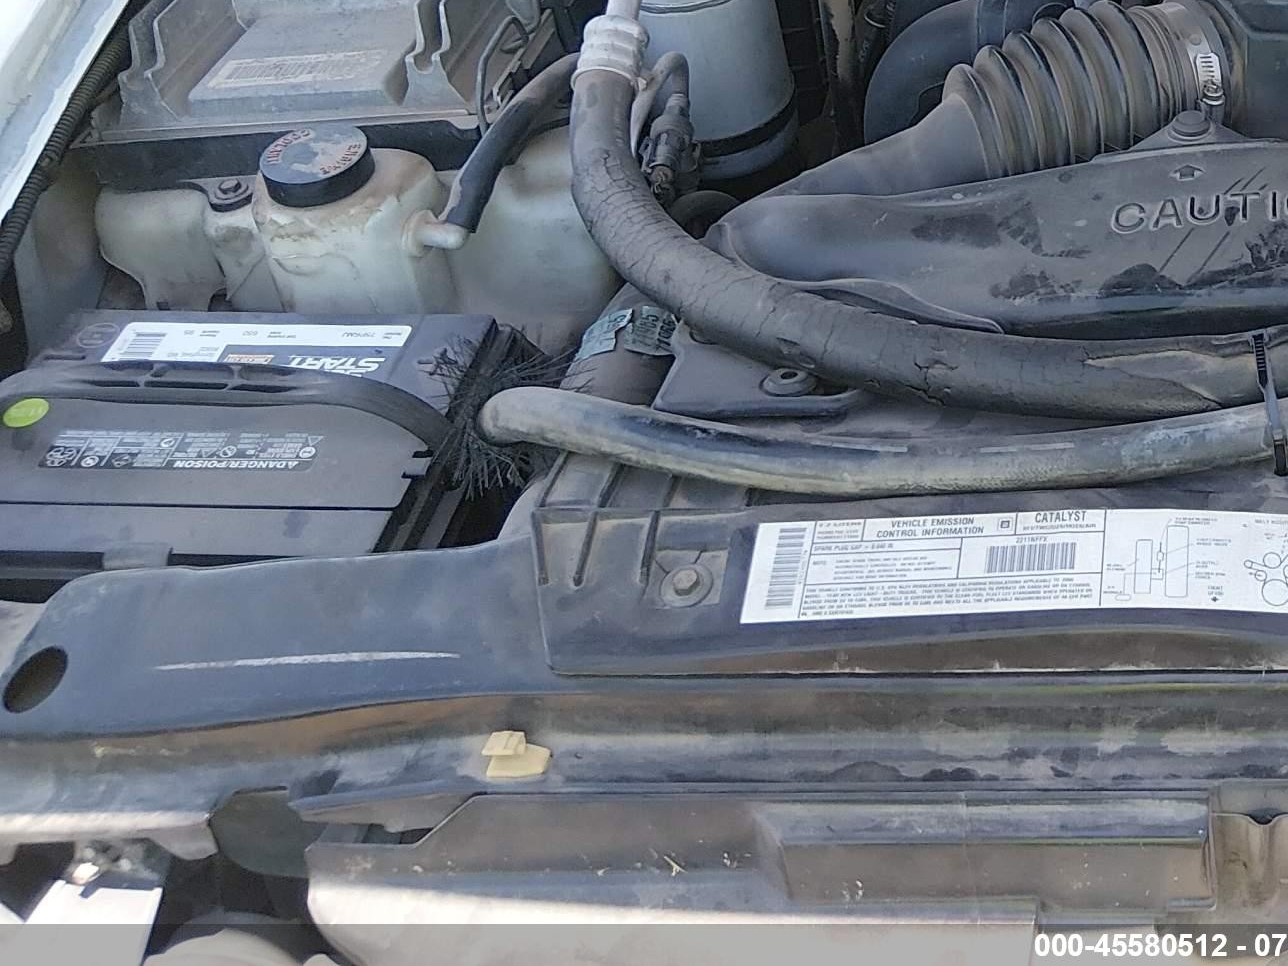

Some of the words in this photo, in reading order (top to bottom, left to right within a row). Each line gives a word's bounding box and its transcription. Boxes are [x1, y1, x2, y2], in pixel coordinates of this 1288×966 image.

[173, 459, 288, 469] DANGER/POISON
[891, 519, 928, 528] VEHICLE
[930, 516, 974, 526] EMISSION
[1034, 510, 1087, 523] CATALYST
[876, 528, 918, 538] CONTROL
[921, 526, 985, 537] INFORMATION
